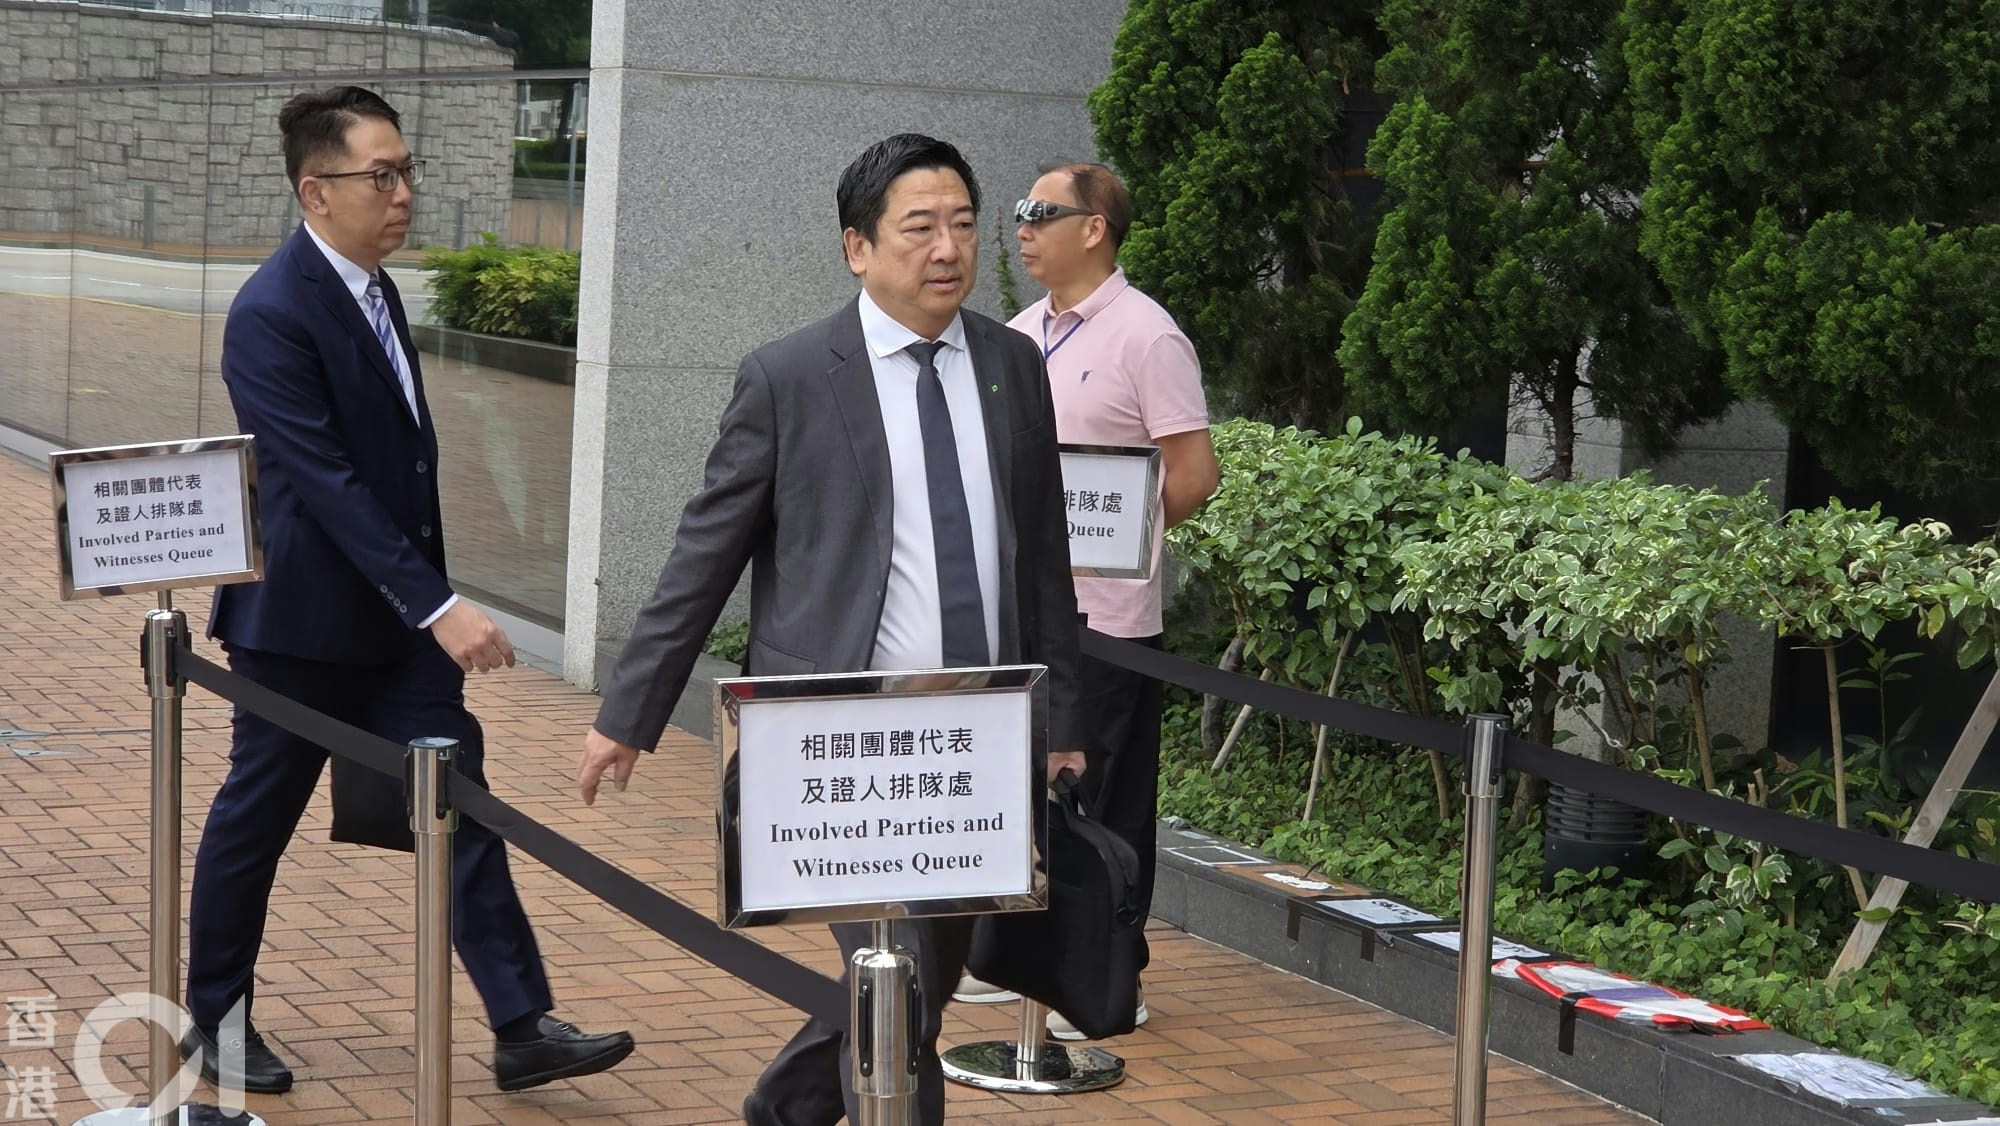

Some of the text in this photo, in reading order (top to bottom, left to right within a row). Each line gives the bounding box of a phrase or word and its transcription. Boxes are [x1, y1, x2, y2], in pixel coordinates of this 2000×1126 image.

[93, 473, 203, 499] 相關團體代表
[96, 499, 204, 525] 及證人排隊處
[78, 522, 225, 549] Involved Parties and
[93, 547, 214, 569] Witnesses Queue
[800, 727, 973, 761] 相關團體代表
[800, 770, 973, 805] 及證人排隊處
[770, 812, 1004, 844] Involved Parties and
[792, 852, 983, 878] Witnesses Queue
